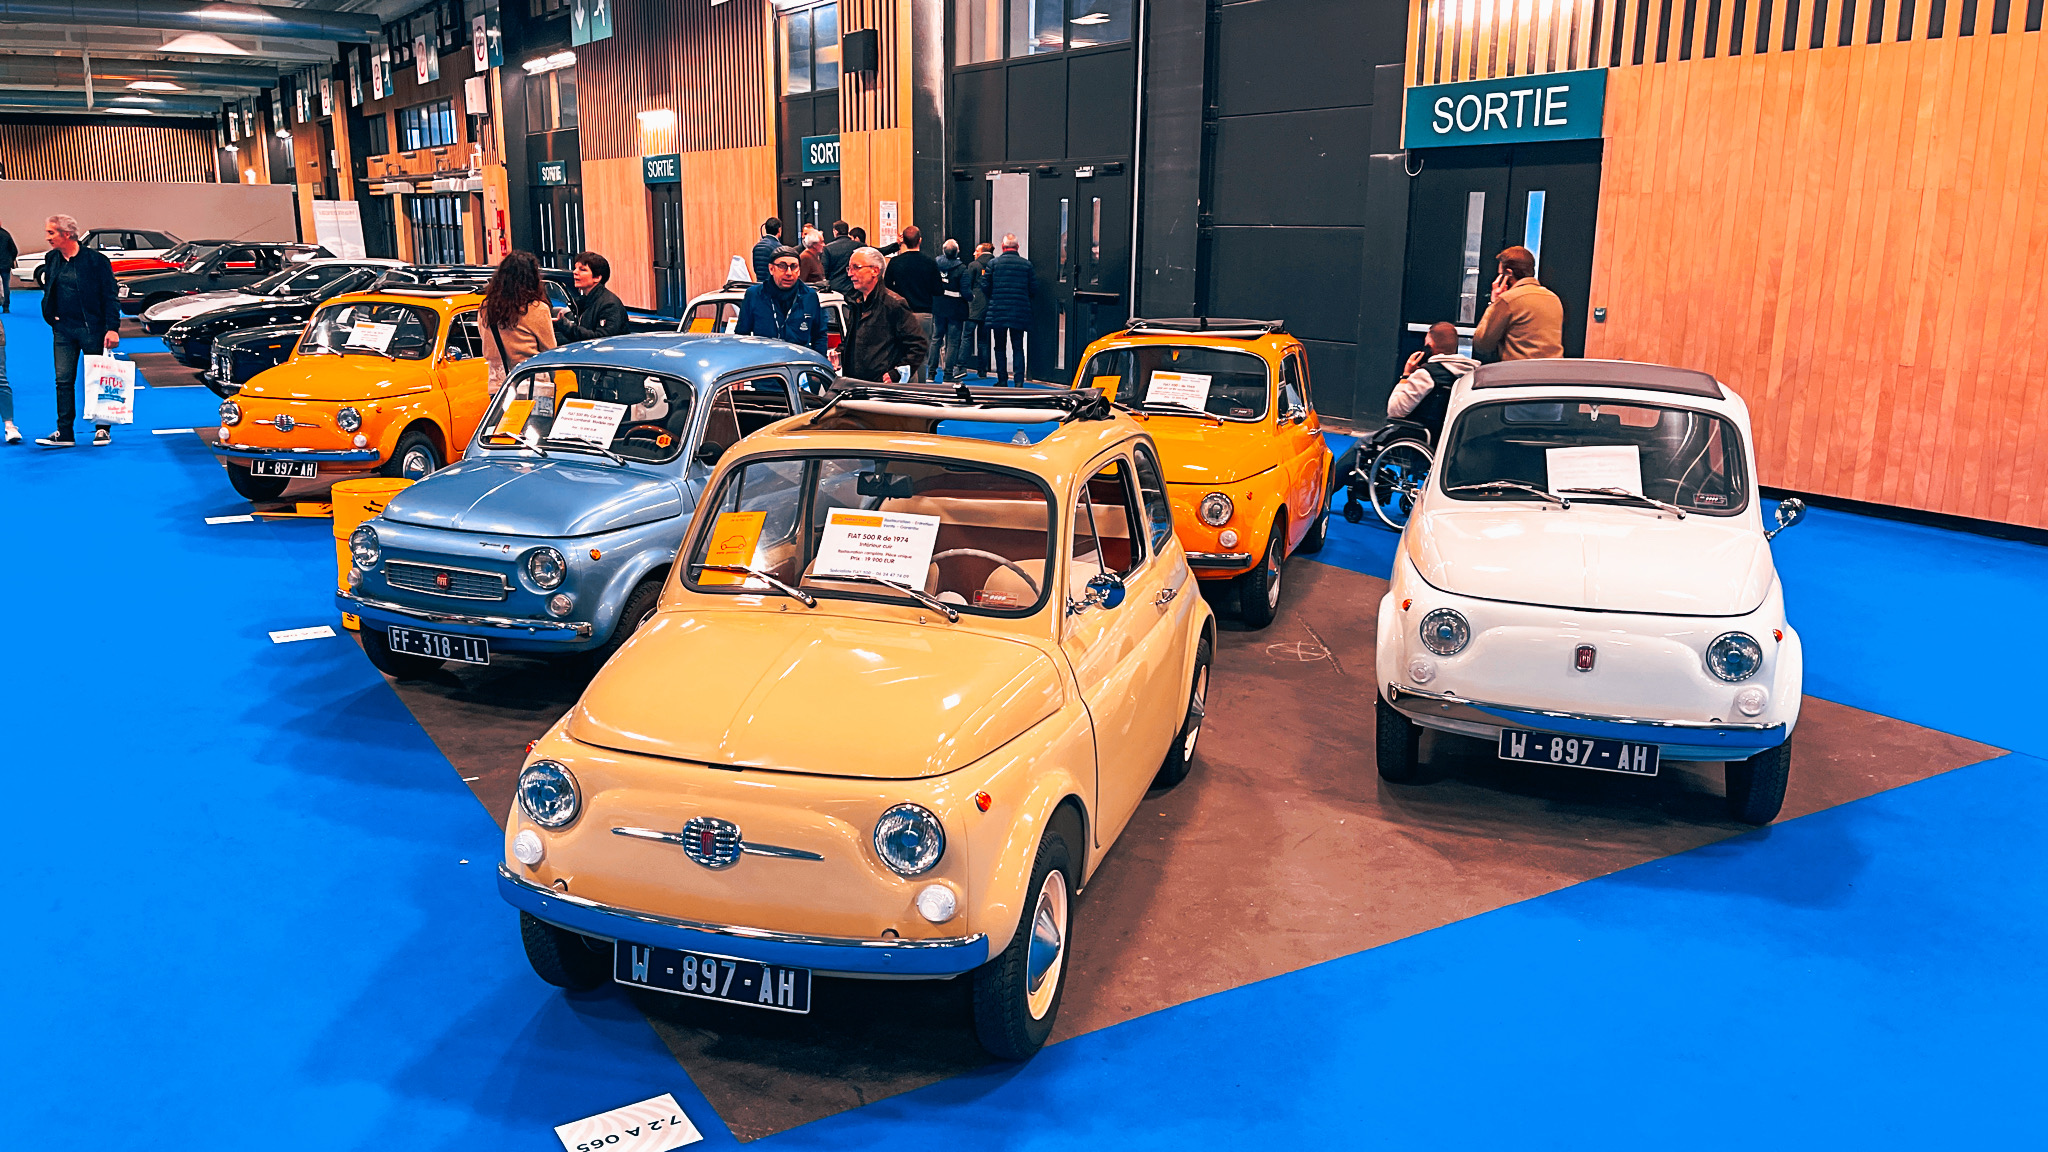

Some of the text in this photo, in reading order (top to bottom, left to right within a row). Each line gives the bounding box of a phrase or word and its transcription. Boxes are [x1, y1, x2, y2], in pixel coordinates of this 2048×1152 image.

[1432, 85, 1570, 134] SORTIE
[541, 166, 561, 181] SORTIE
[647, 159, 674, 178] SORTIE
[862, 533, 875, 541] 500
[625, 1126, 640, 1137] A
